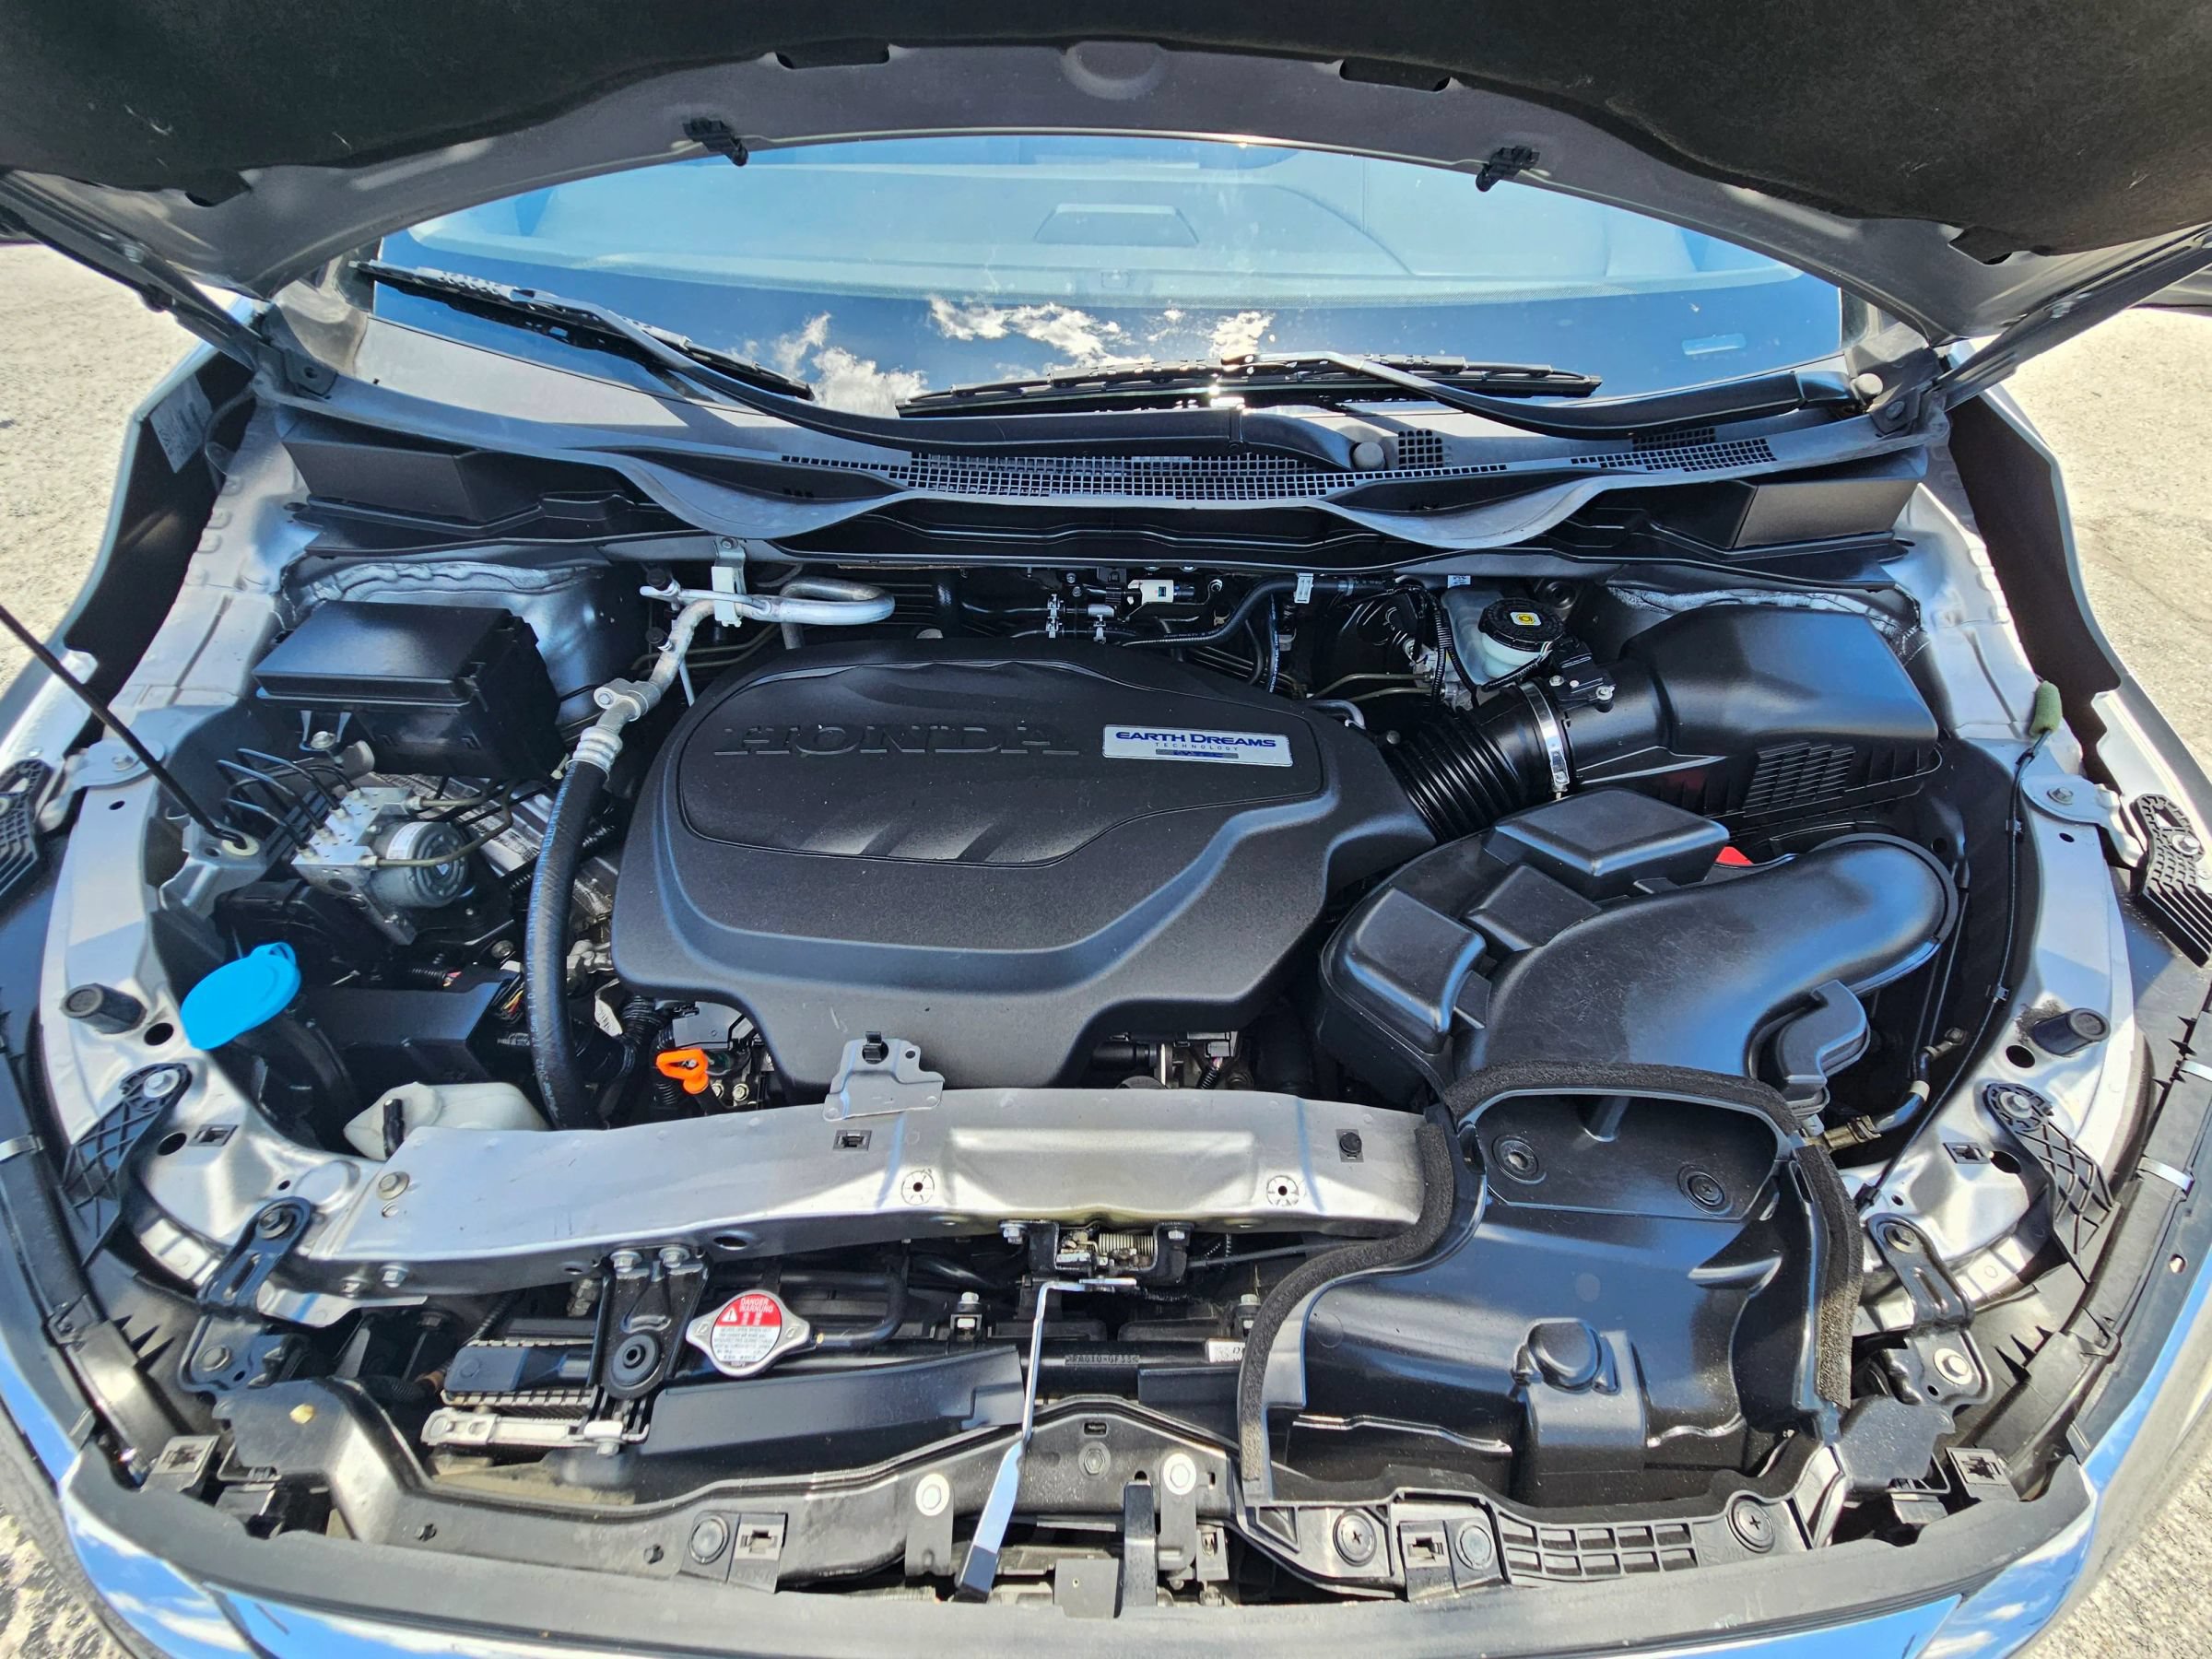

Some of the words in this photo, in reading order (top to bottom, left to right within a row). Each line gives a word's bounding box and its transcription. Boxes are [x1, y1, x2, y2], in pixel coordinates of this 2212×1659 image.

[714, 724, 1079, 756] HONDA
[1115, 731, 1186, 743] EARTH
[1189, 733, 1277, 747] DREAMS
[1155, 742, 1239, 751] TECHNOLOGY
[526, 987, 536, 1009] I.D.
[530, 1014, 541, 1048] 17.5mm
[740, 1297, 770, 1305] DANGER
